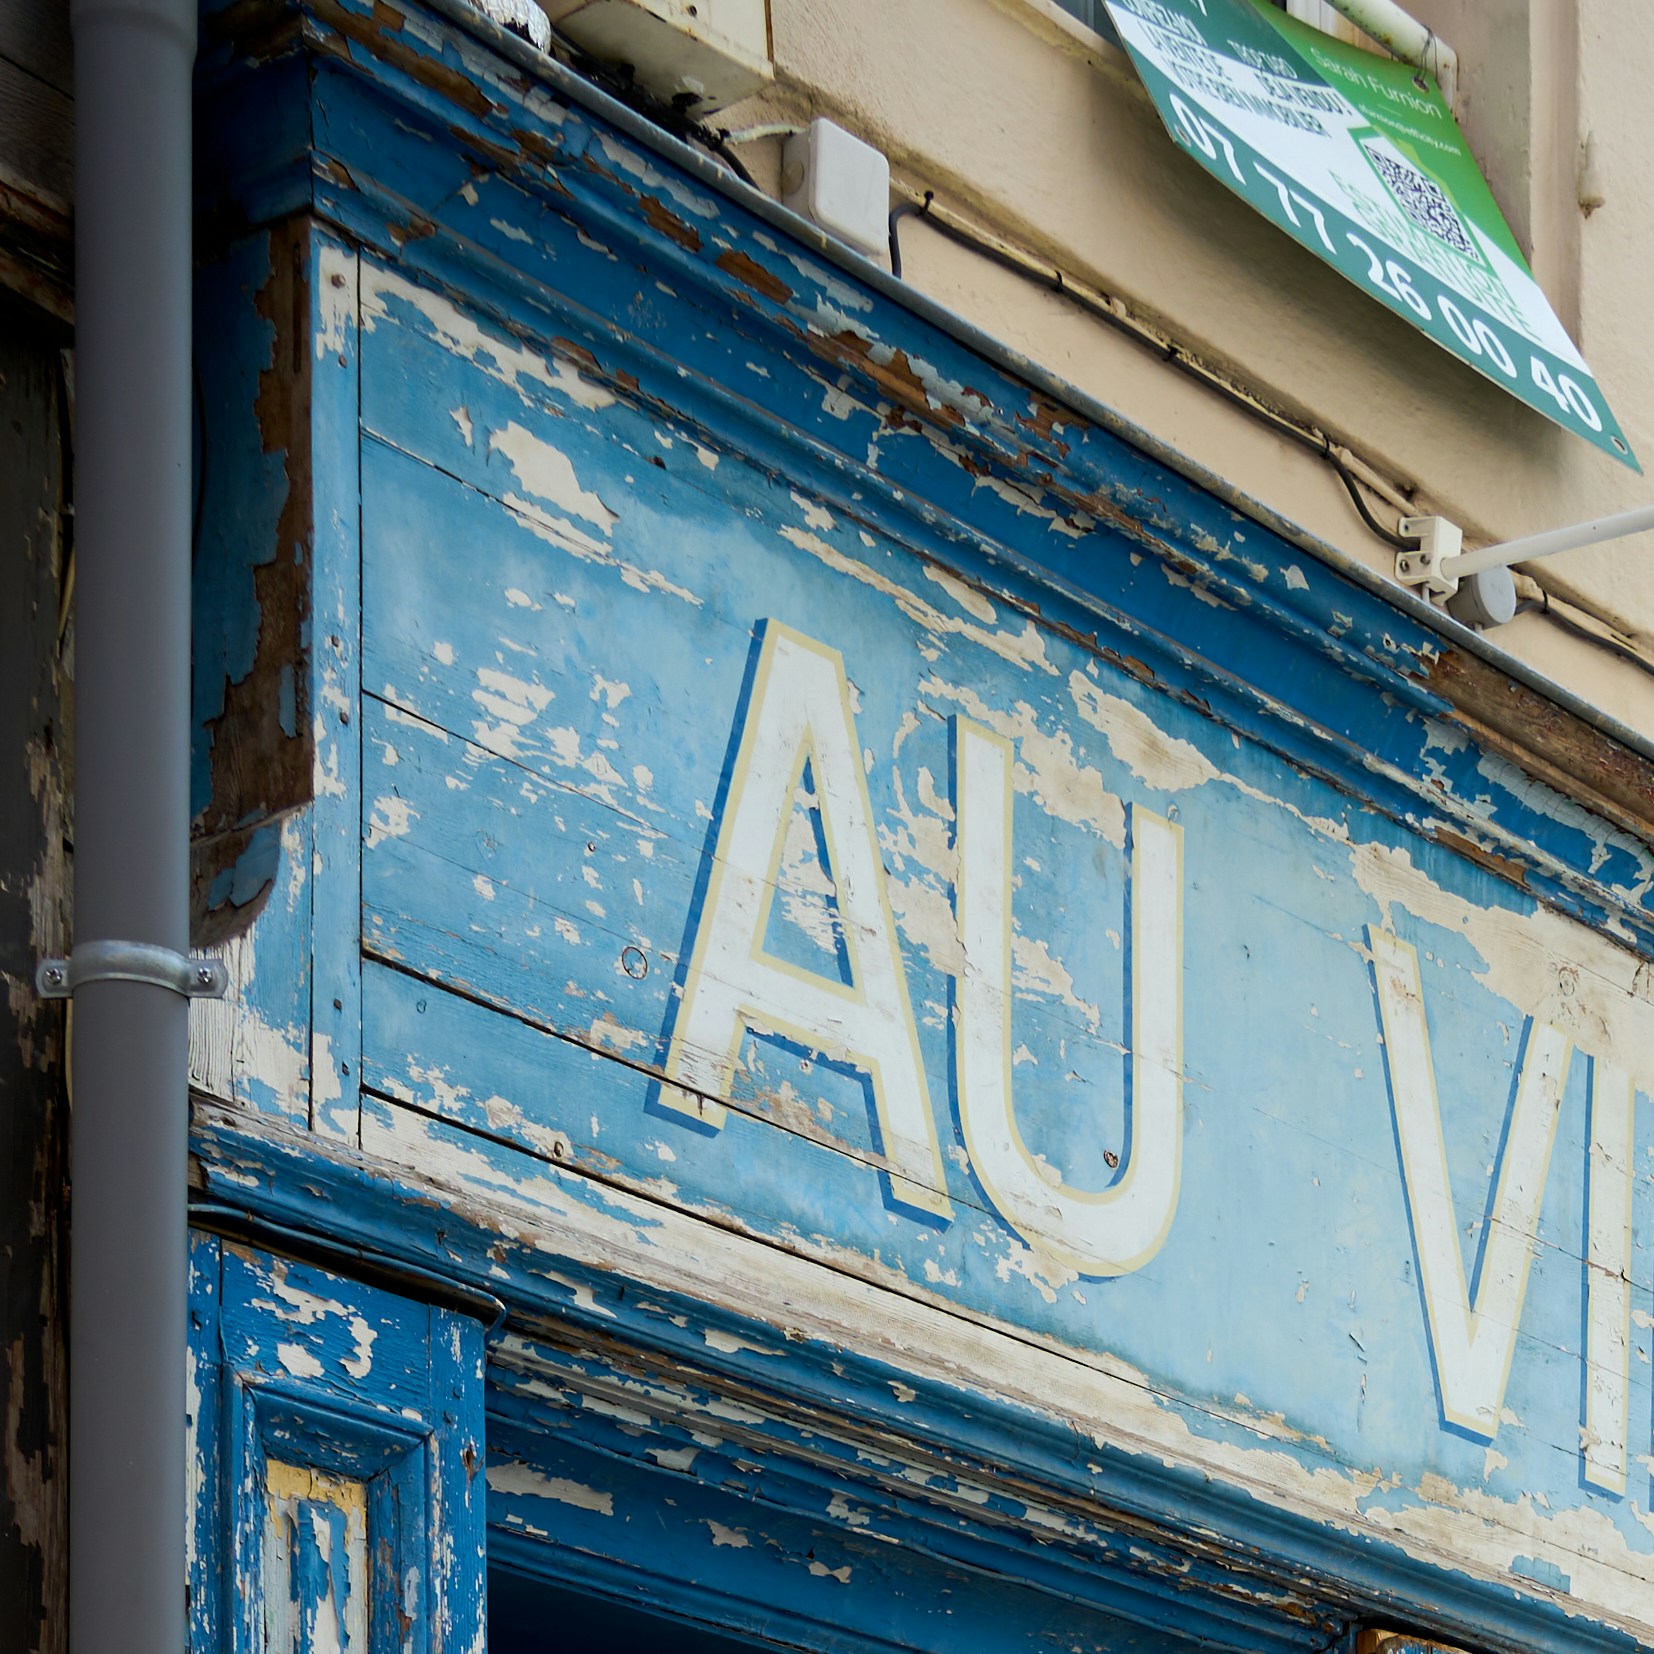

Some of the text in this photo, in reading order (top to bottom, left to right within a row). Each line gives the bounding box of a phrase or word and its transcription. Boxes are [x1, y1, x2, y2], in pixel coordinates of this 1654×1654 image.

[1153, 29, 1212, 74] VENTE
[1207, 77, 1254, 113] BIEN
[1234, 86, 1332, 138] IMMOBILIER
[1310, 46, 1368, 89] Sarah
[1170, 93, 1602, 432] 07 77 26 00 40
[1327, 168, 1516, 306] ESTIMATION
[1352, 201, 1542, 342] GRATUITE
[645, 617, 1184, 1282] AU
